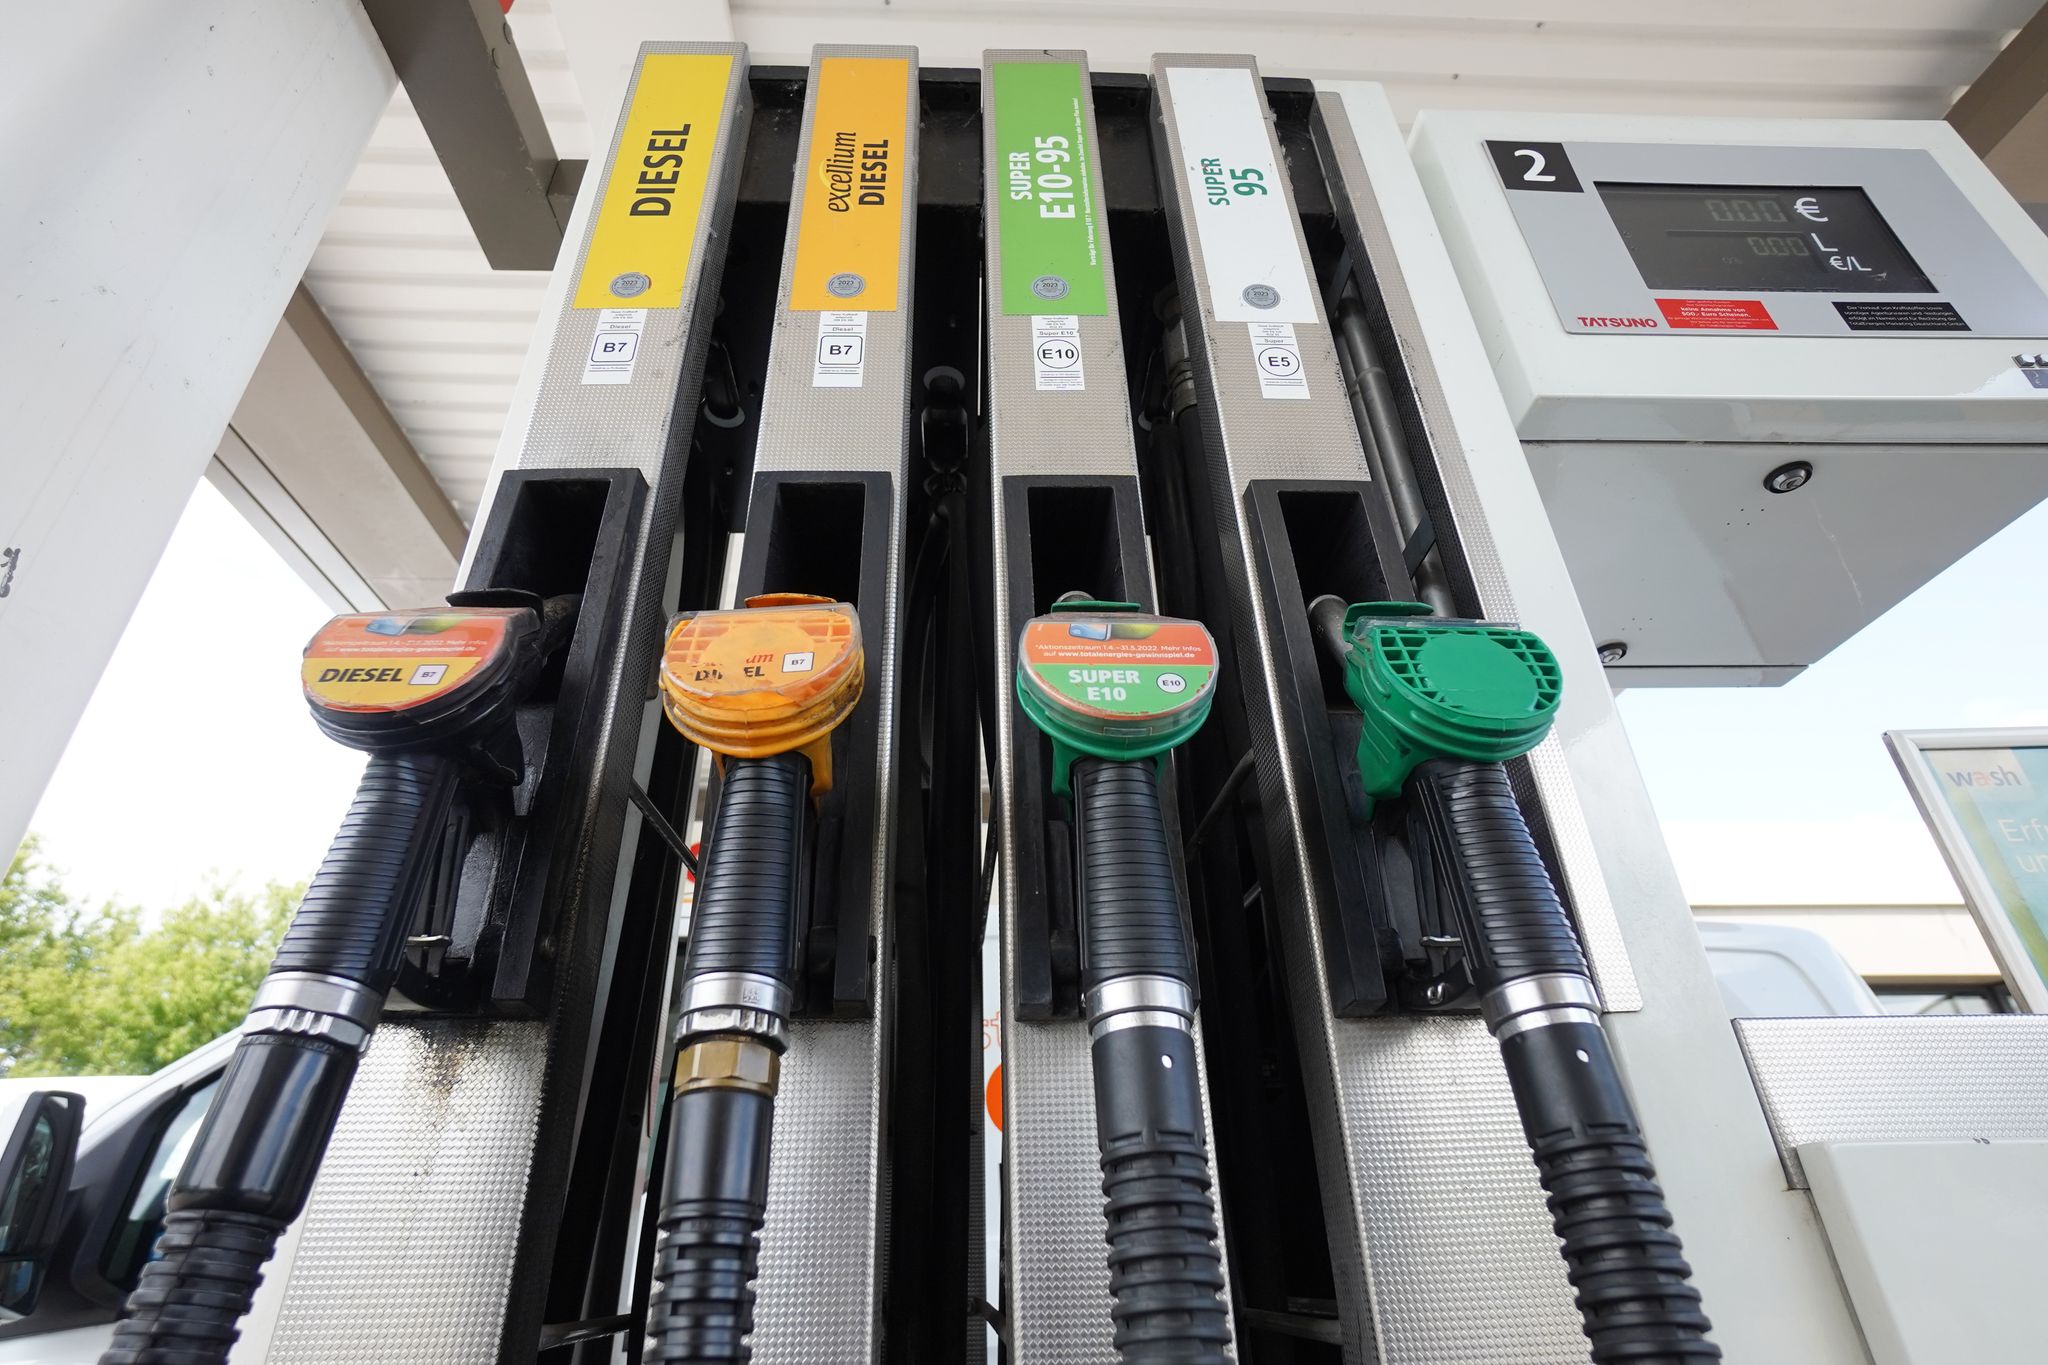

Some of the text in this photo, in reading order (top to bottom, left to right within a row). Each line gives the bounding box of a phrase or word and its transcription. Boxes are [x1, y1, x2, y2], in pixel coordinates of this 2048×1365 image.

[629, 123, 692, 217] DIESEL
[826, 131, 857, 213] excellium
[858, 139, 889, 206] DIESEL
[1008, 151, 1033, 200] SUPER
[1514, 149, 1556, 182] 2
[1034, 135, 1076, 219] E10-95
[1200, 158, 1230, 205] SUPER
[1229, 168, 1268, 196] 95
[1794, 197, 1829, 222] €
[1811, 233, 1839, 251] L
[1829, 255, 1872, 271] €/L
[1577, 316, 1658, 328] TATSUNO
[603, 342, 628, 353] B7
[829, 345, 853, 355] B7
[1042, 348, 1075, 359] E10
[1268, 356, 1291, 367] E5
[1058, 651, 1196, 659] www.totalenergies-gewinnspiel.de
[318, 668, 403, 683] DIESEL
[1068, 670, 1141, 684] SUPER
[1087, 687, 1127, 701] E10
[1946, 765, 2022, 787] wash
[1998, 818, 2048, 841] Erf
